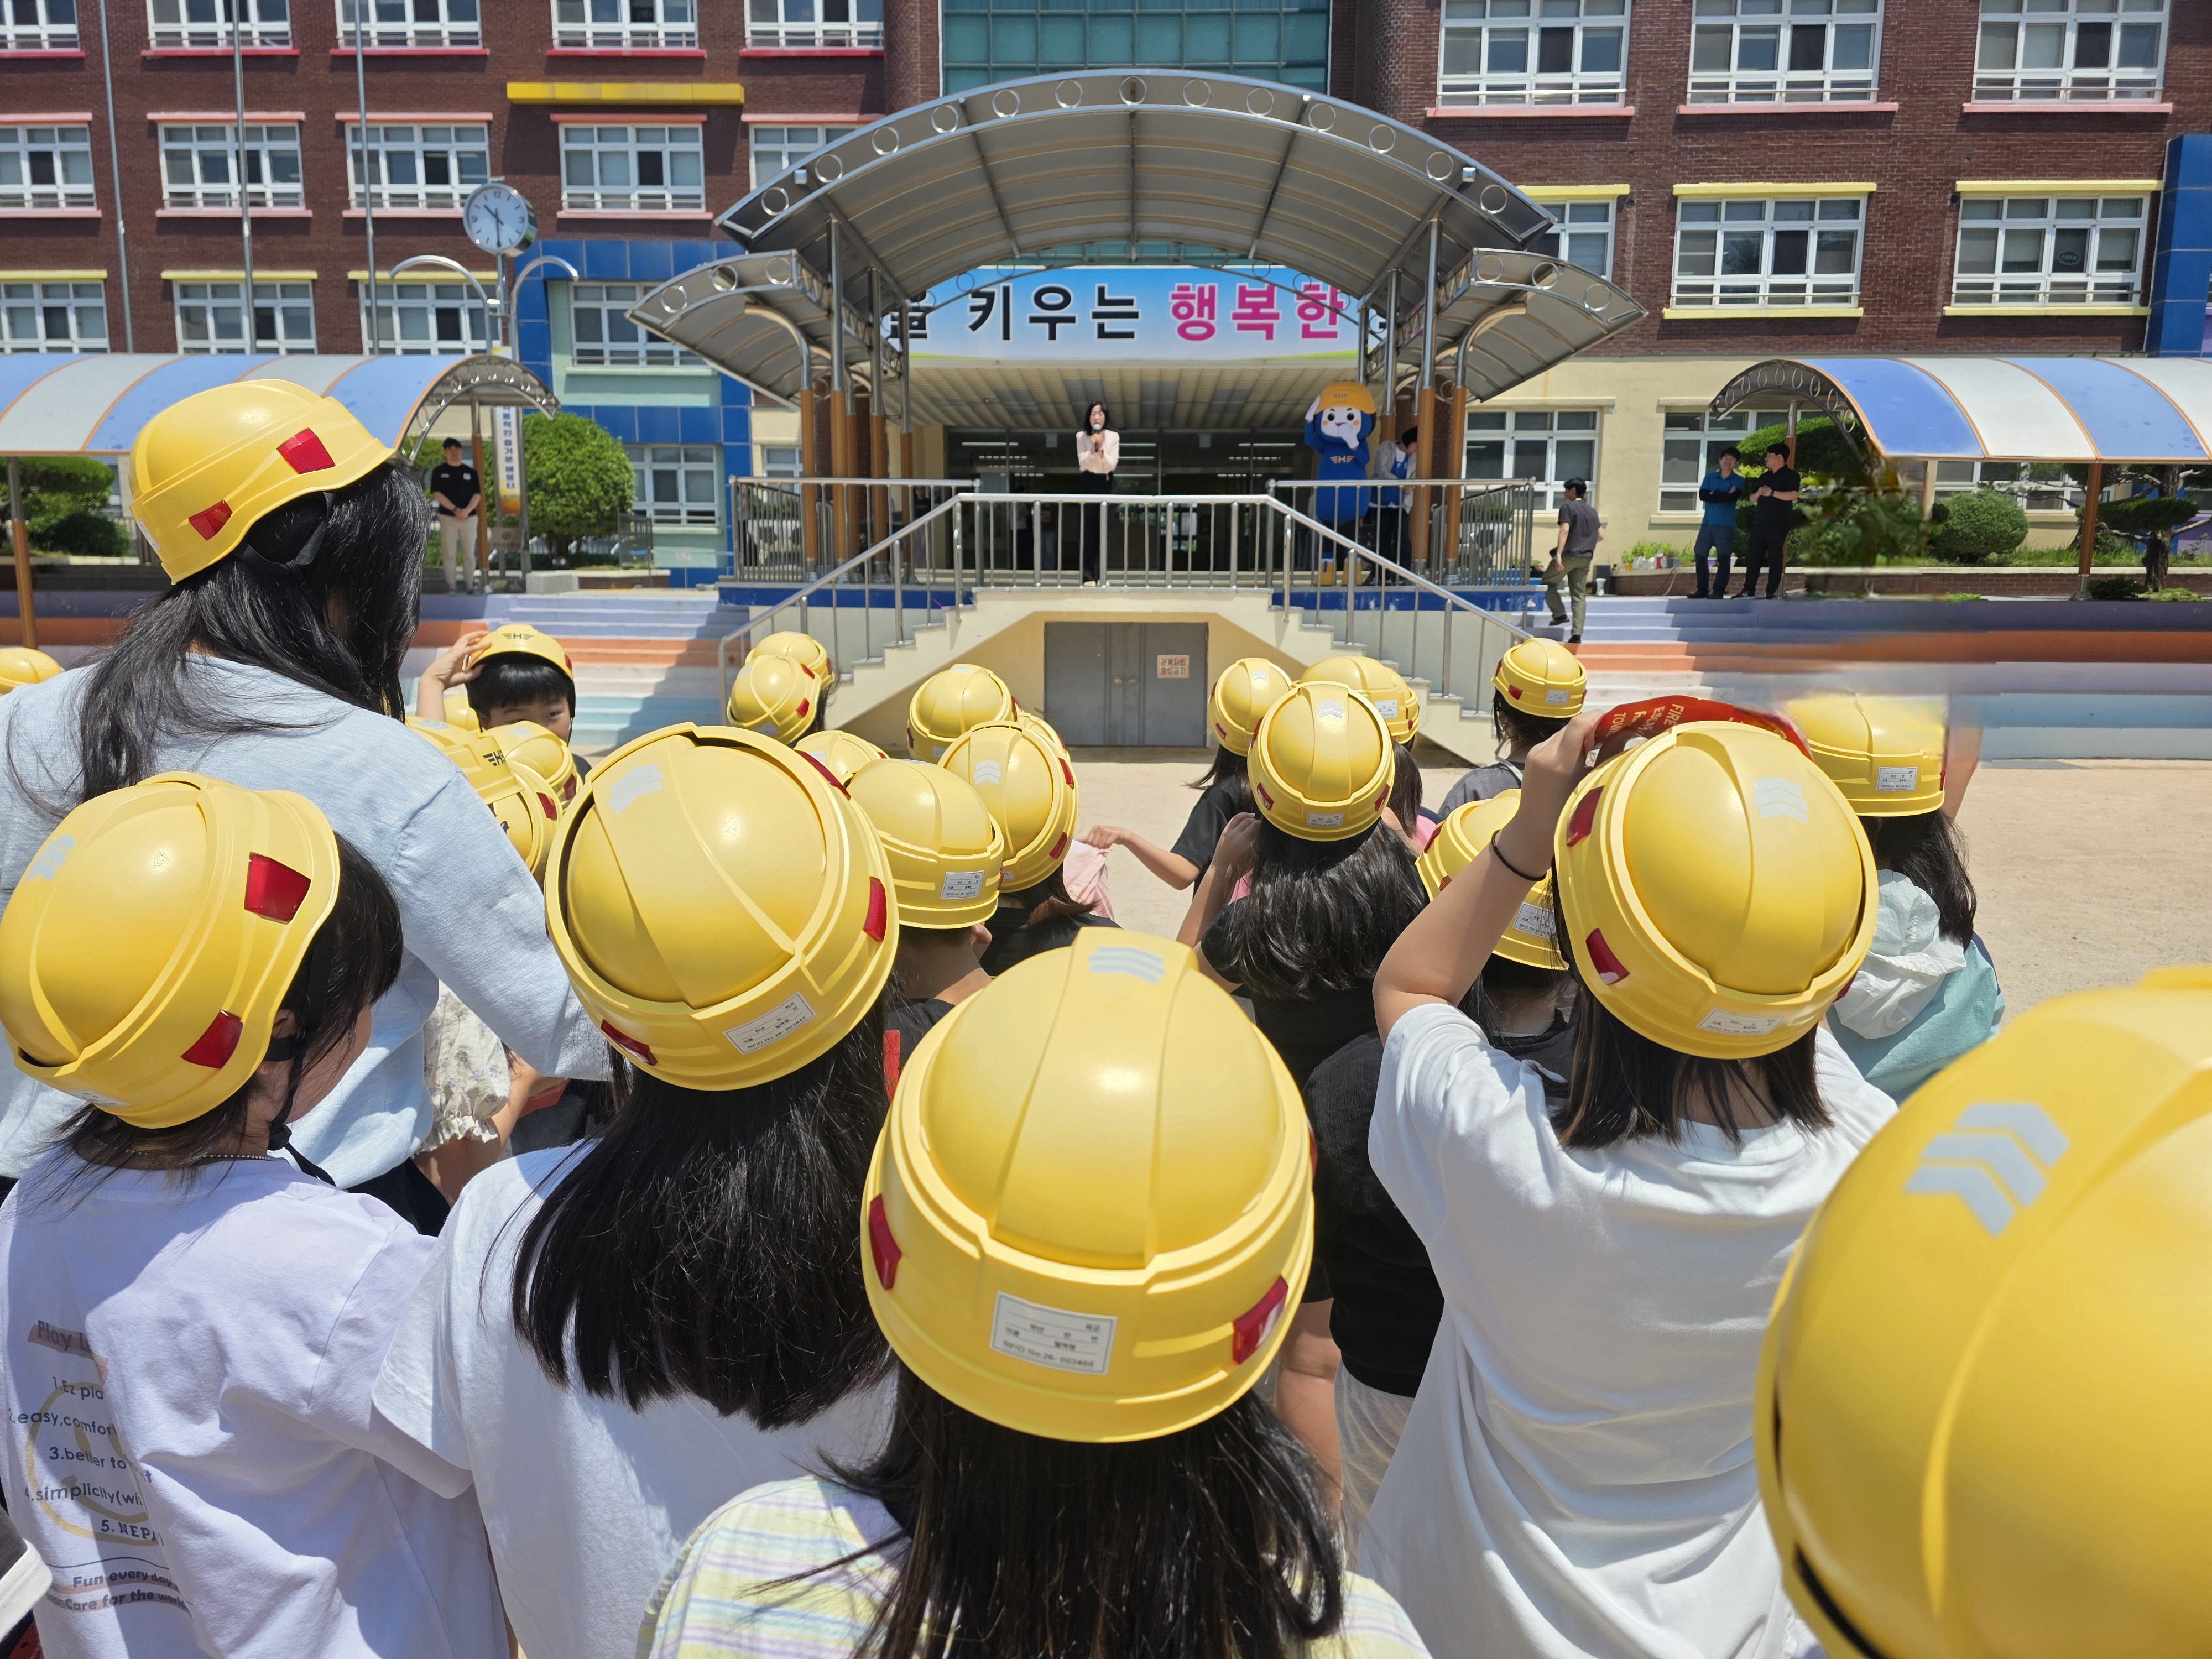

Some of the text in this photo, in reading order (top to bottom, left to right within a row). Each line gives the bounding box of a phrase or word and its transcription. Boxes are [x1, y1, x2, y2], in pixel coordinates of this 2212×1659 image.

[967, 285, 1140, 341] 키우는
[1169, 283, 1345, 341] 행복한
[1663, 703, 1684, 726] FIRE
[747, 1041, 763, 1050] RFID
[37, 1319, 72, 1351] Play
[81, 1385, 105, 1400] pla
[110, 1457, 127, 1469] to
[73, 1575, 104, 1589] Fun
[109, 1569, 148, 1582] every
[65, 1599, 97, 1612] Care
[103, 1593, 126, 1608] for
[131, 1589, 154, 1601] the
